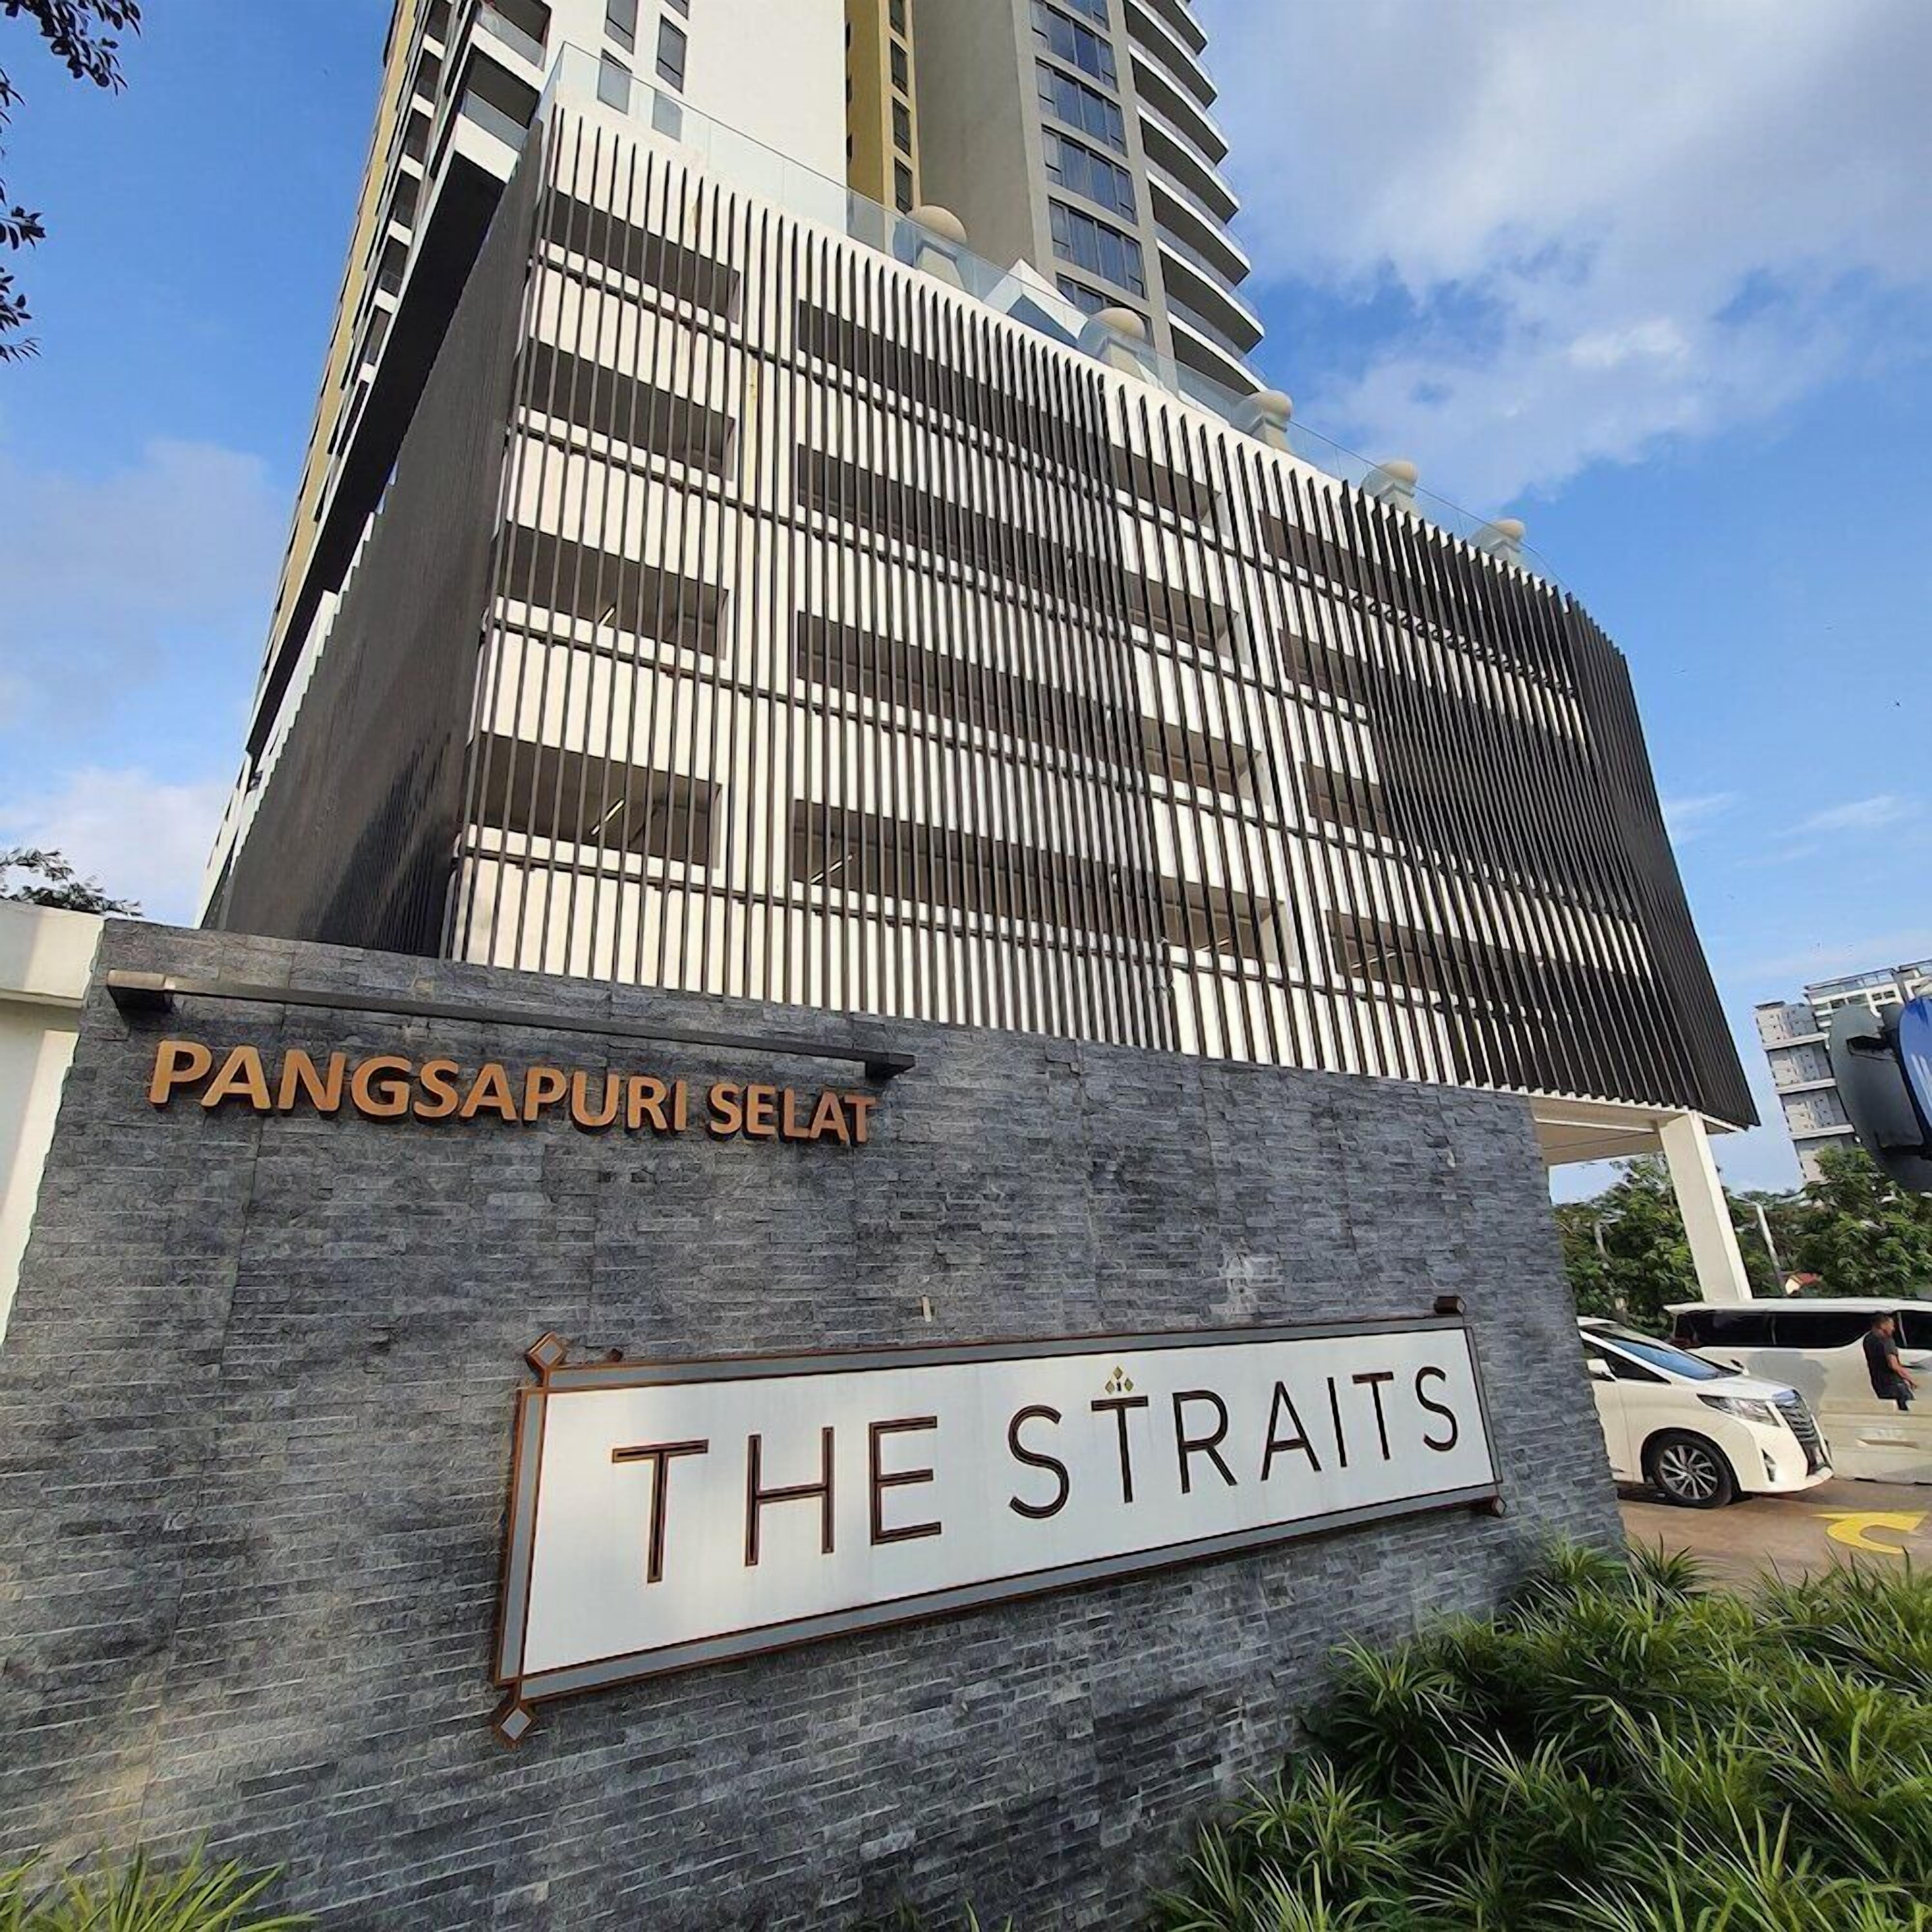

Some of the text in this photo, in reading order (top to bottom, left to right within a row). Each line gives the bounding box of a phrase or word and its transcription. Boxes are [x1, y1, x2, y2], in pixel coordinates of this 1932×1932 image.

[148, 1038, 876, 1145] PANGSAPURI SELAT
[612, 1365, 1460, 1585] THE STRAITS
